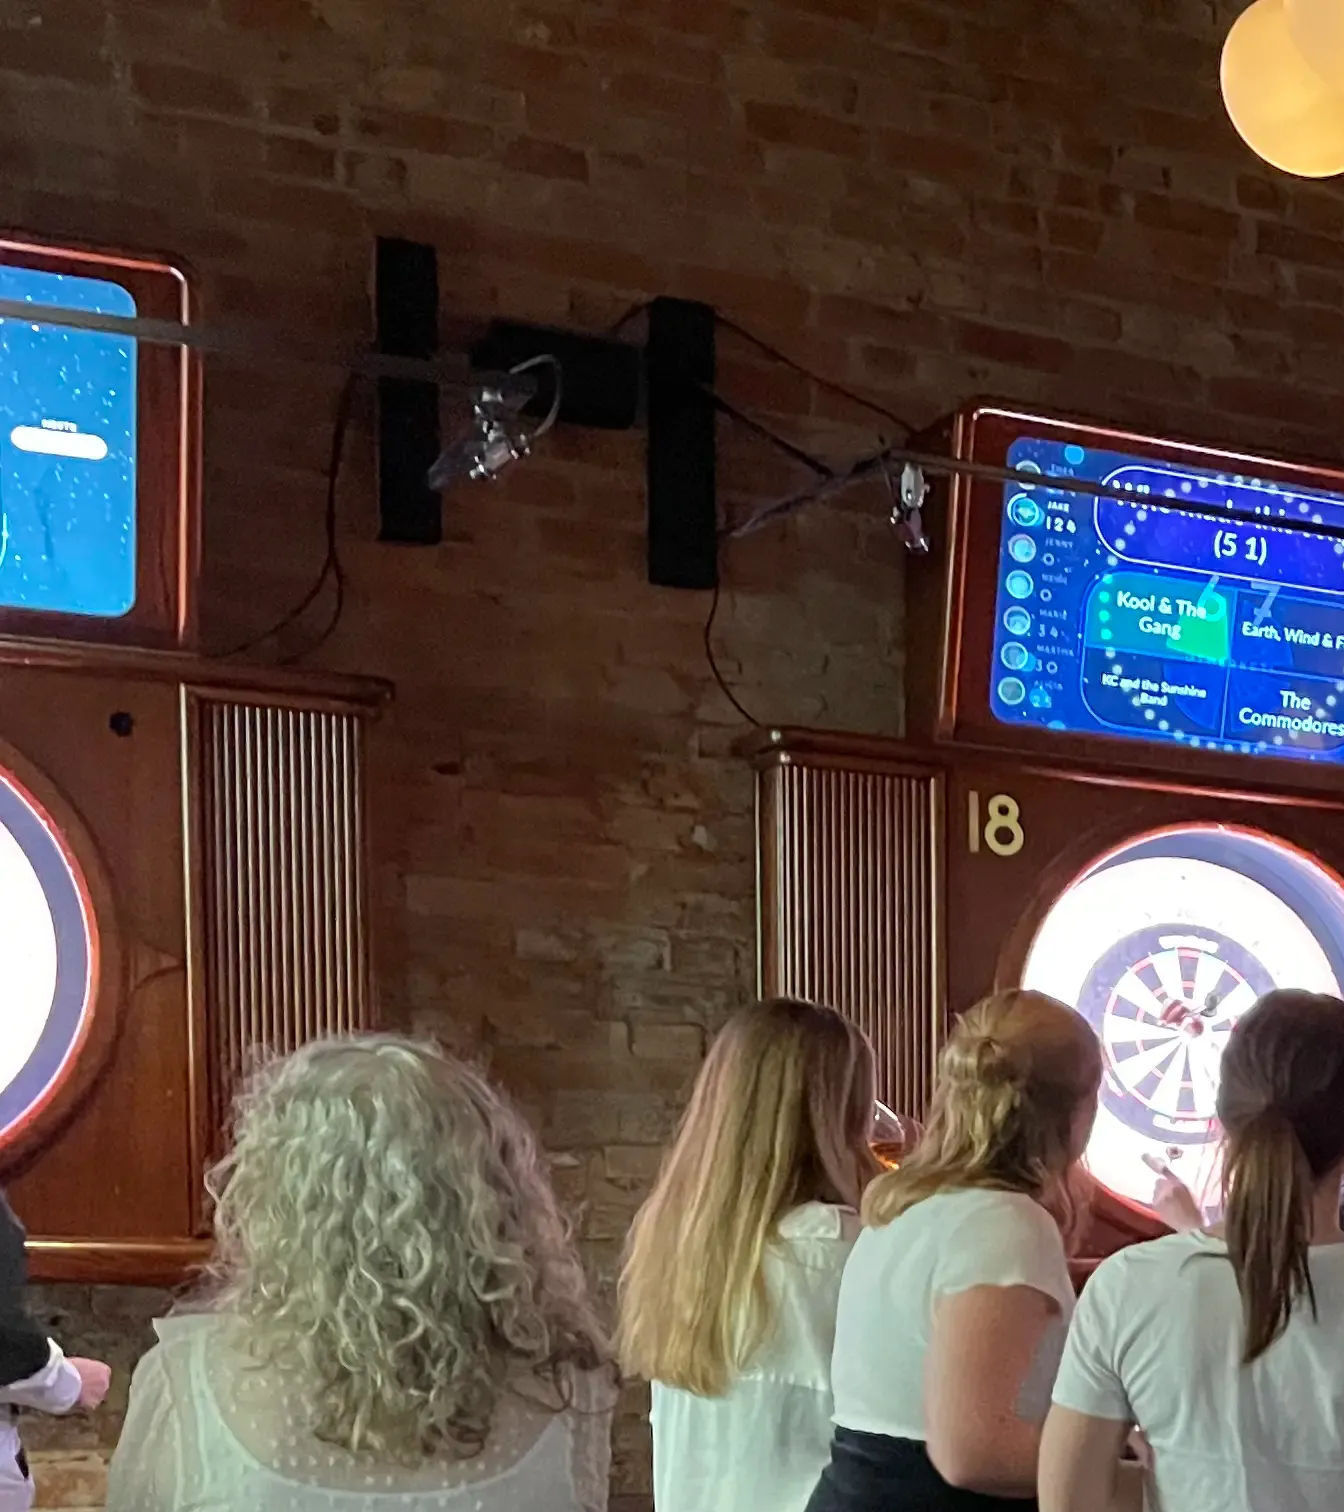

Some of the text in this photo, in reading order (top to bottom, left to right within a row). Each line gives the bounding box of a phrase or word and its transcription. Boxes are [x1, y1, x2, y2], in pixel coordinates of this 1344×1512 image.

[1117, 590, 1207, 619] Kool & The
[1138, 616, 1181, 641] Gang
[1242, 621, 1282, 642] Earth,
[1284, 627, 1320, 647] Wind
[1321, 633, 1334, 649] &
[1102, 673, 1207, 699] KC and the Sunshine
[1140, 692, 1168, 707] Band
[1280, 690, 1312, 711] The
[968, 790, 1025, 857] 18
